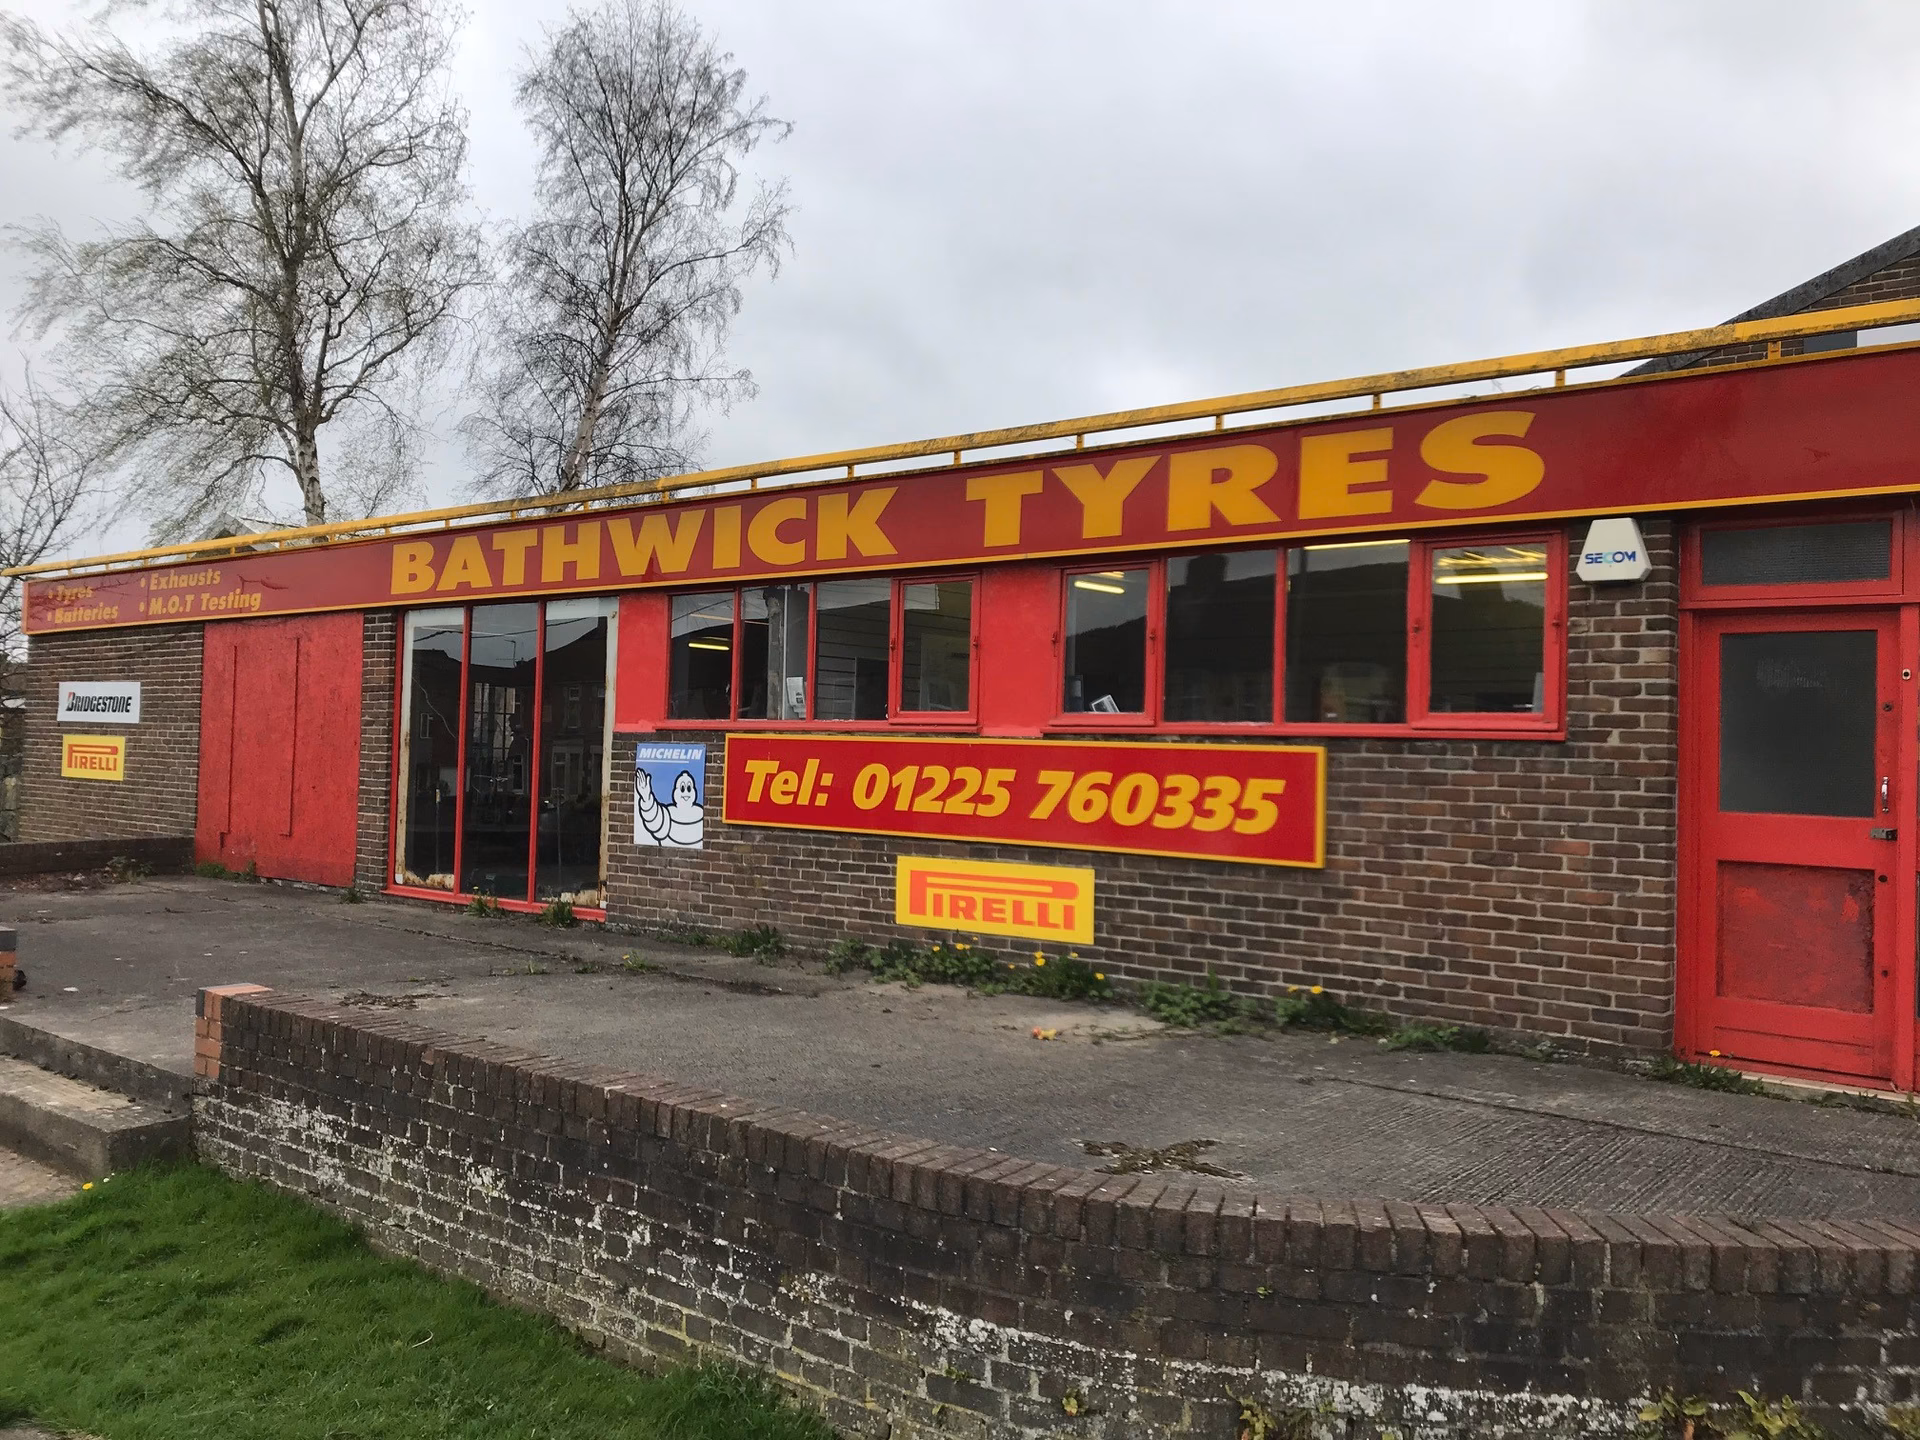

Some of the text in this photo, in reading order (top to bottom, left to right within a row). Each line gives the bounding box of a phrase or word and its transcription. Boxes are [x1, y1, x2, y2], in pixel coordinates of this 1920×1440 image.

[390, 410, 1546, 595] BATHWICK TYRES
[1585, 551, 1636, 564] SECOM
[150, 568, 221, 590] Exhausts
[56, 585, 93, 605] Tyres
[200, 588, 262, 611] Testing
[55, 602, 119, 624] Batteries
[65, 692, 132, 713] BRIDGESTONE
[67, 744, 119, 771] PIRELLI
[639, 747, 703, 760] MICHELIN
[744, 758, 1286, 835] Tel: 01225 760335
[909, 870, 1079, 931] PIRELLI
